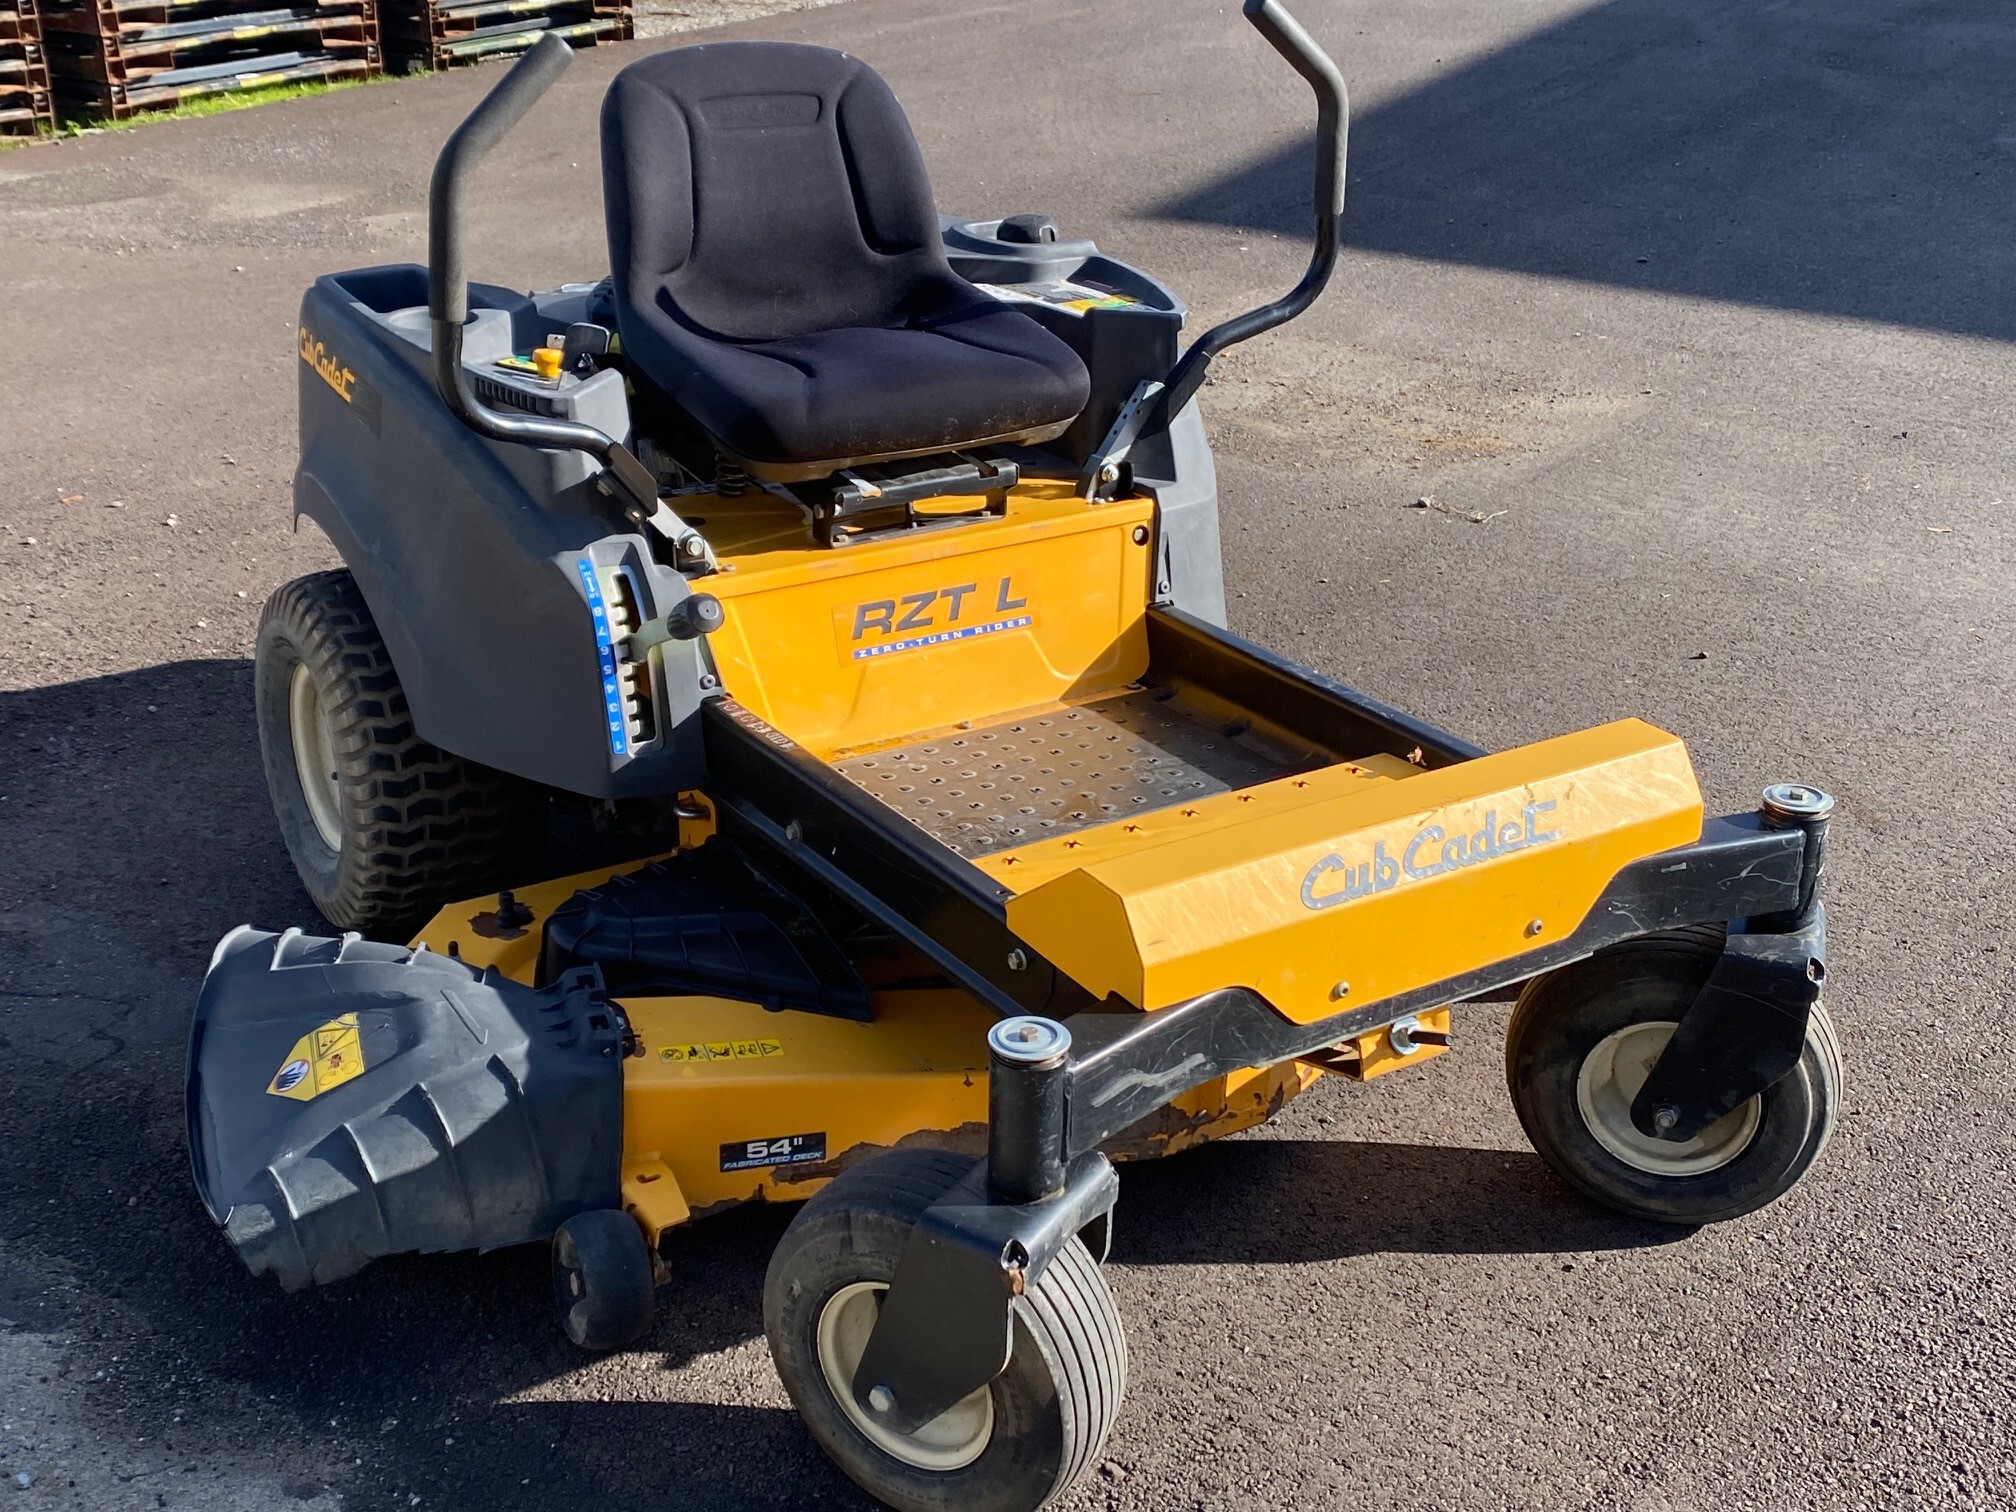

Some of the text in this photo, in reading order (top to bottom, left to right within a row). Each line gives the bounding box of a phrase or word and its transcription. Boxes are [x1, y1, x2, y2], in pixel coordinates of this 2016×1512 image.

[299, 326, 355, 404] Cub Cadet
[593, 606, 603, 617] 8
[852, 576, 1028, 640] RZT L
[598, 626, 607, 636] 7
[974, 618, 1027, 635] RIDER
[600, 646, 610, 656] 6
[603, 664, 612, 675] 5
[605, 683, 615, 694] 4
[608, 702, 618, 713] 3
[610, 721, 620, 732] 2
[614, 741, 623, 751] 1
[1300, 799, 1564, 910] Cub Cadet
[746, 1137, 803, 1159] 54"
[723, 1151, 823, 1170] FABRICATED DECK
